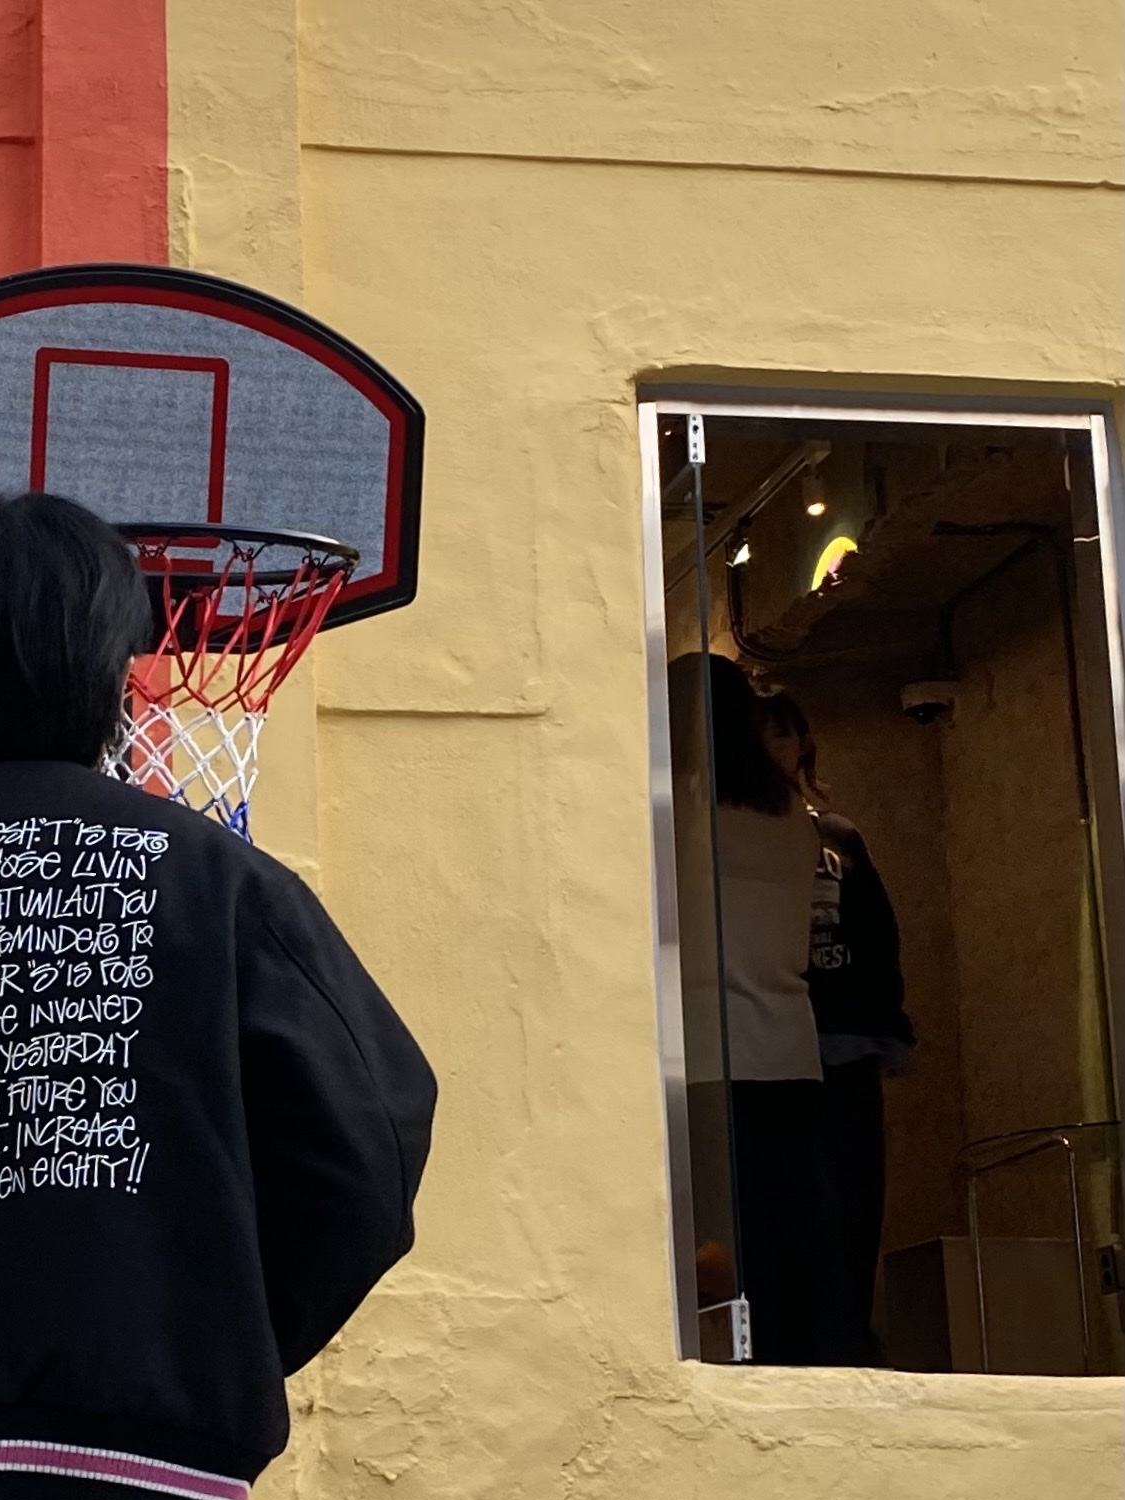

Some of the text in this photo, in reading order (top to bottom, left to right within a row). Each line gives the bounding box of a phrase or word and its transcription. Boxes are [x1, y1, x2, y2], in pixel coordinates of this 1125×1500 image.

[75, 823, 106, 845] IS
[112, 826, 169, 853] FOR
[20, 882, 120, 919] UMLAUT
[113, 887, 157, 919] YOU
[122, 920, 154, 951] TO
[66, 962, 92, 988] IS
[100, 955, 154, 988] FOR
[91, 1075, 137, 1108] YOU
